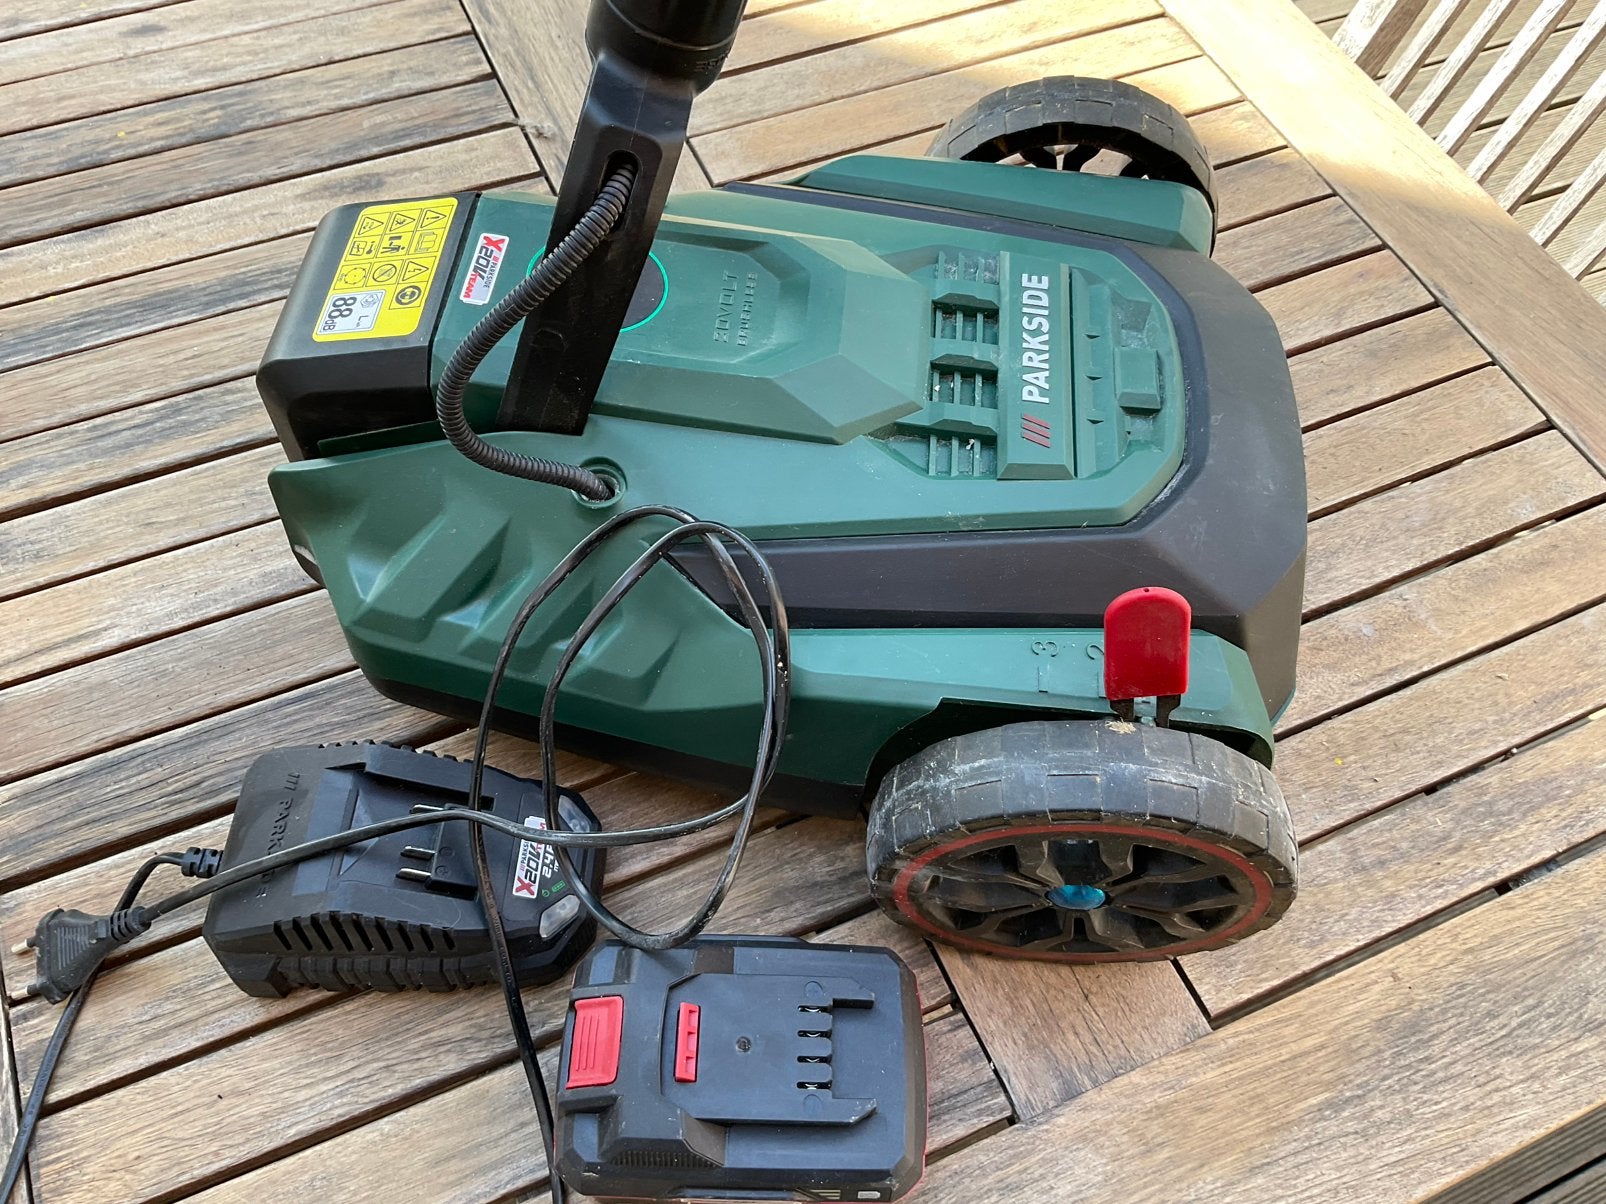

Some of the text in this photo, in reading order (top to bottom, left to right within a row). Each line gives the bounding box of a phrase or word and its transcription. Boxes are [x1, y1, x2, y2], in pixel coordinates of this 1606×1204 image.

[463, 273, 477, 299] TEAM
[483, 261, 498, 289] PARKSIDE
[1021, 273, 1050, 404] PARKSIDE
[1031, 641, 1059, 658] 3
